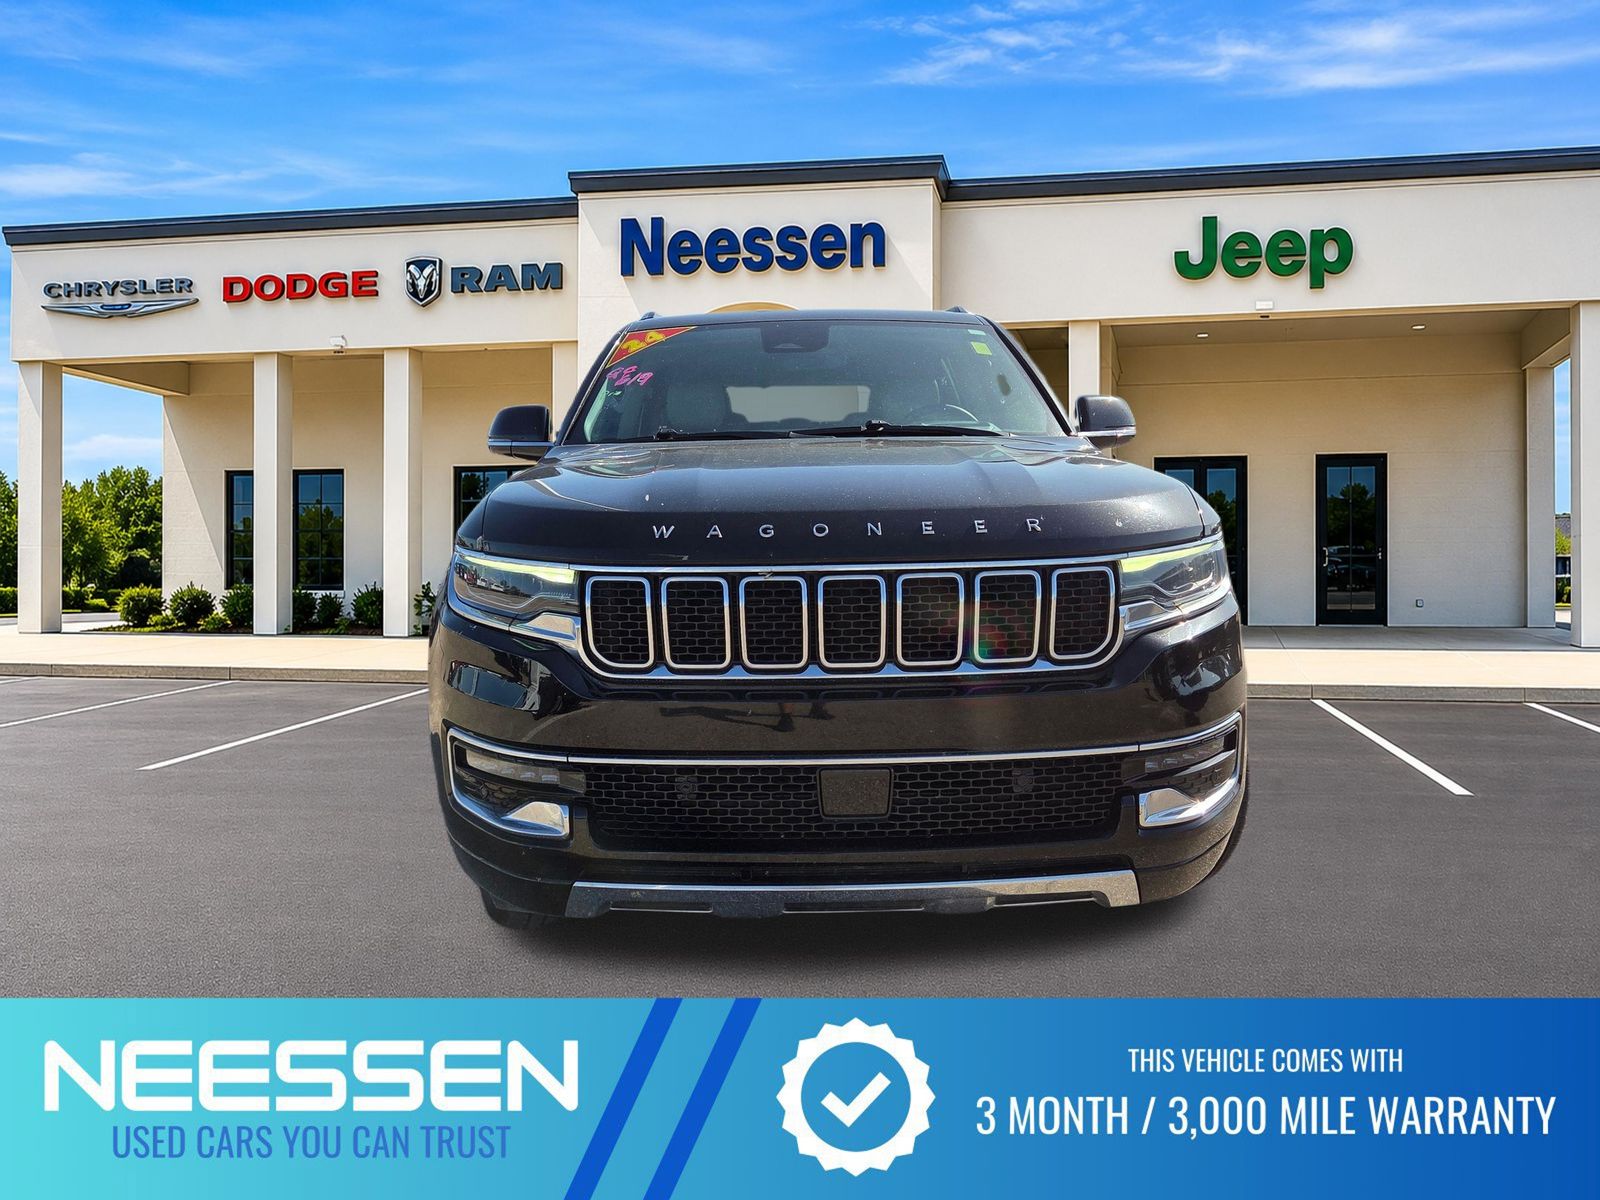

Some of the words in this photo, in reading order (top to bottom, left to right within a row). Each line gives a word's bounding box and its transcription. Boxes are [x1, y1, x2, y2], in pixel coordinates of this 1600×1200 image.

[620, 216, 886, 276] Neessen
[1174, 216, 1353, 290] Jeep
[43, 277, 194, 299] CHRYSLER
[222, 270, 379, 303] DODGE
[450, 262, 564, 294] RAM
[652, 517, 1042, 539] WAGONEER
